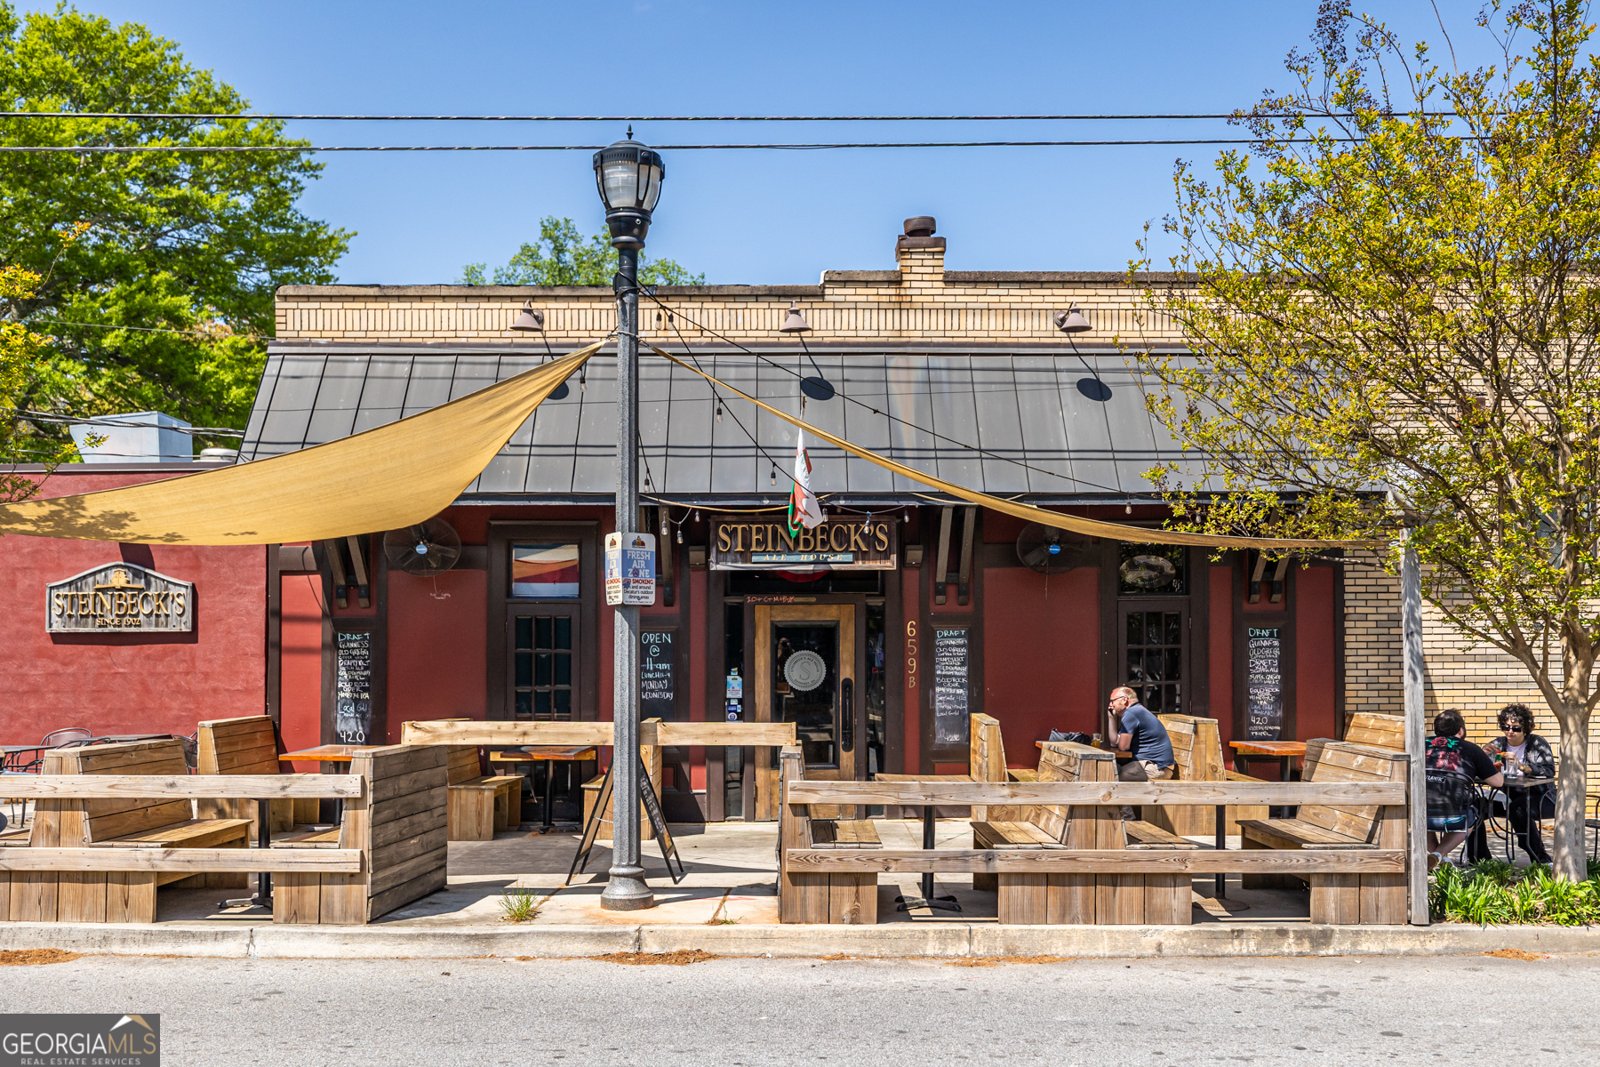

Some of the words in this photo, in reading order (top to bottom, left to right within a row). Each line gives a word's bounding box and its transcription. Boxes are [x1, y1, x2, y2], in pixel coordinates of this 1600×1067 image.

[715, 523, 889, 552] STEINBECK'S
[627, 551, 651, 561] FRESH
[800, 553, 843, 561] HOUSE
[632, 560, 646, 569] AIR
[54, 591, 186, 617] STEINBECK'S
[97, 617, 121, 626] SINCE
[124, 617, 141, 626] 1902
[338, 632, 370, 641] DRAFT
[936, 630, 966, 639] DRAFT
[1248, 628, 1278, 637] DRAFT
[641, 632, 672, 644] OPEN
[339, 641, 369, 649] GUINNESS
[649, 645, 660, 657] @
[641, 680, 668, 690] MONDAY
[1251, 716, 1268, 725] 420
[340, 731, 365, 743] 420
